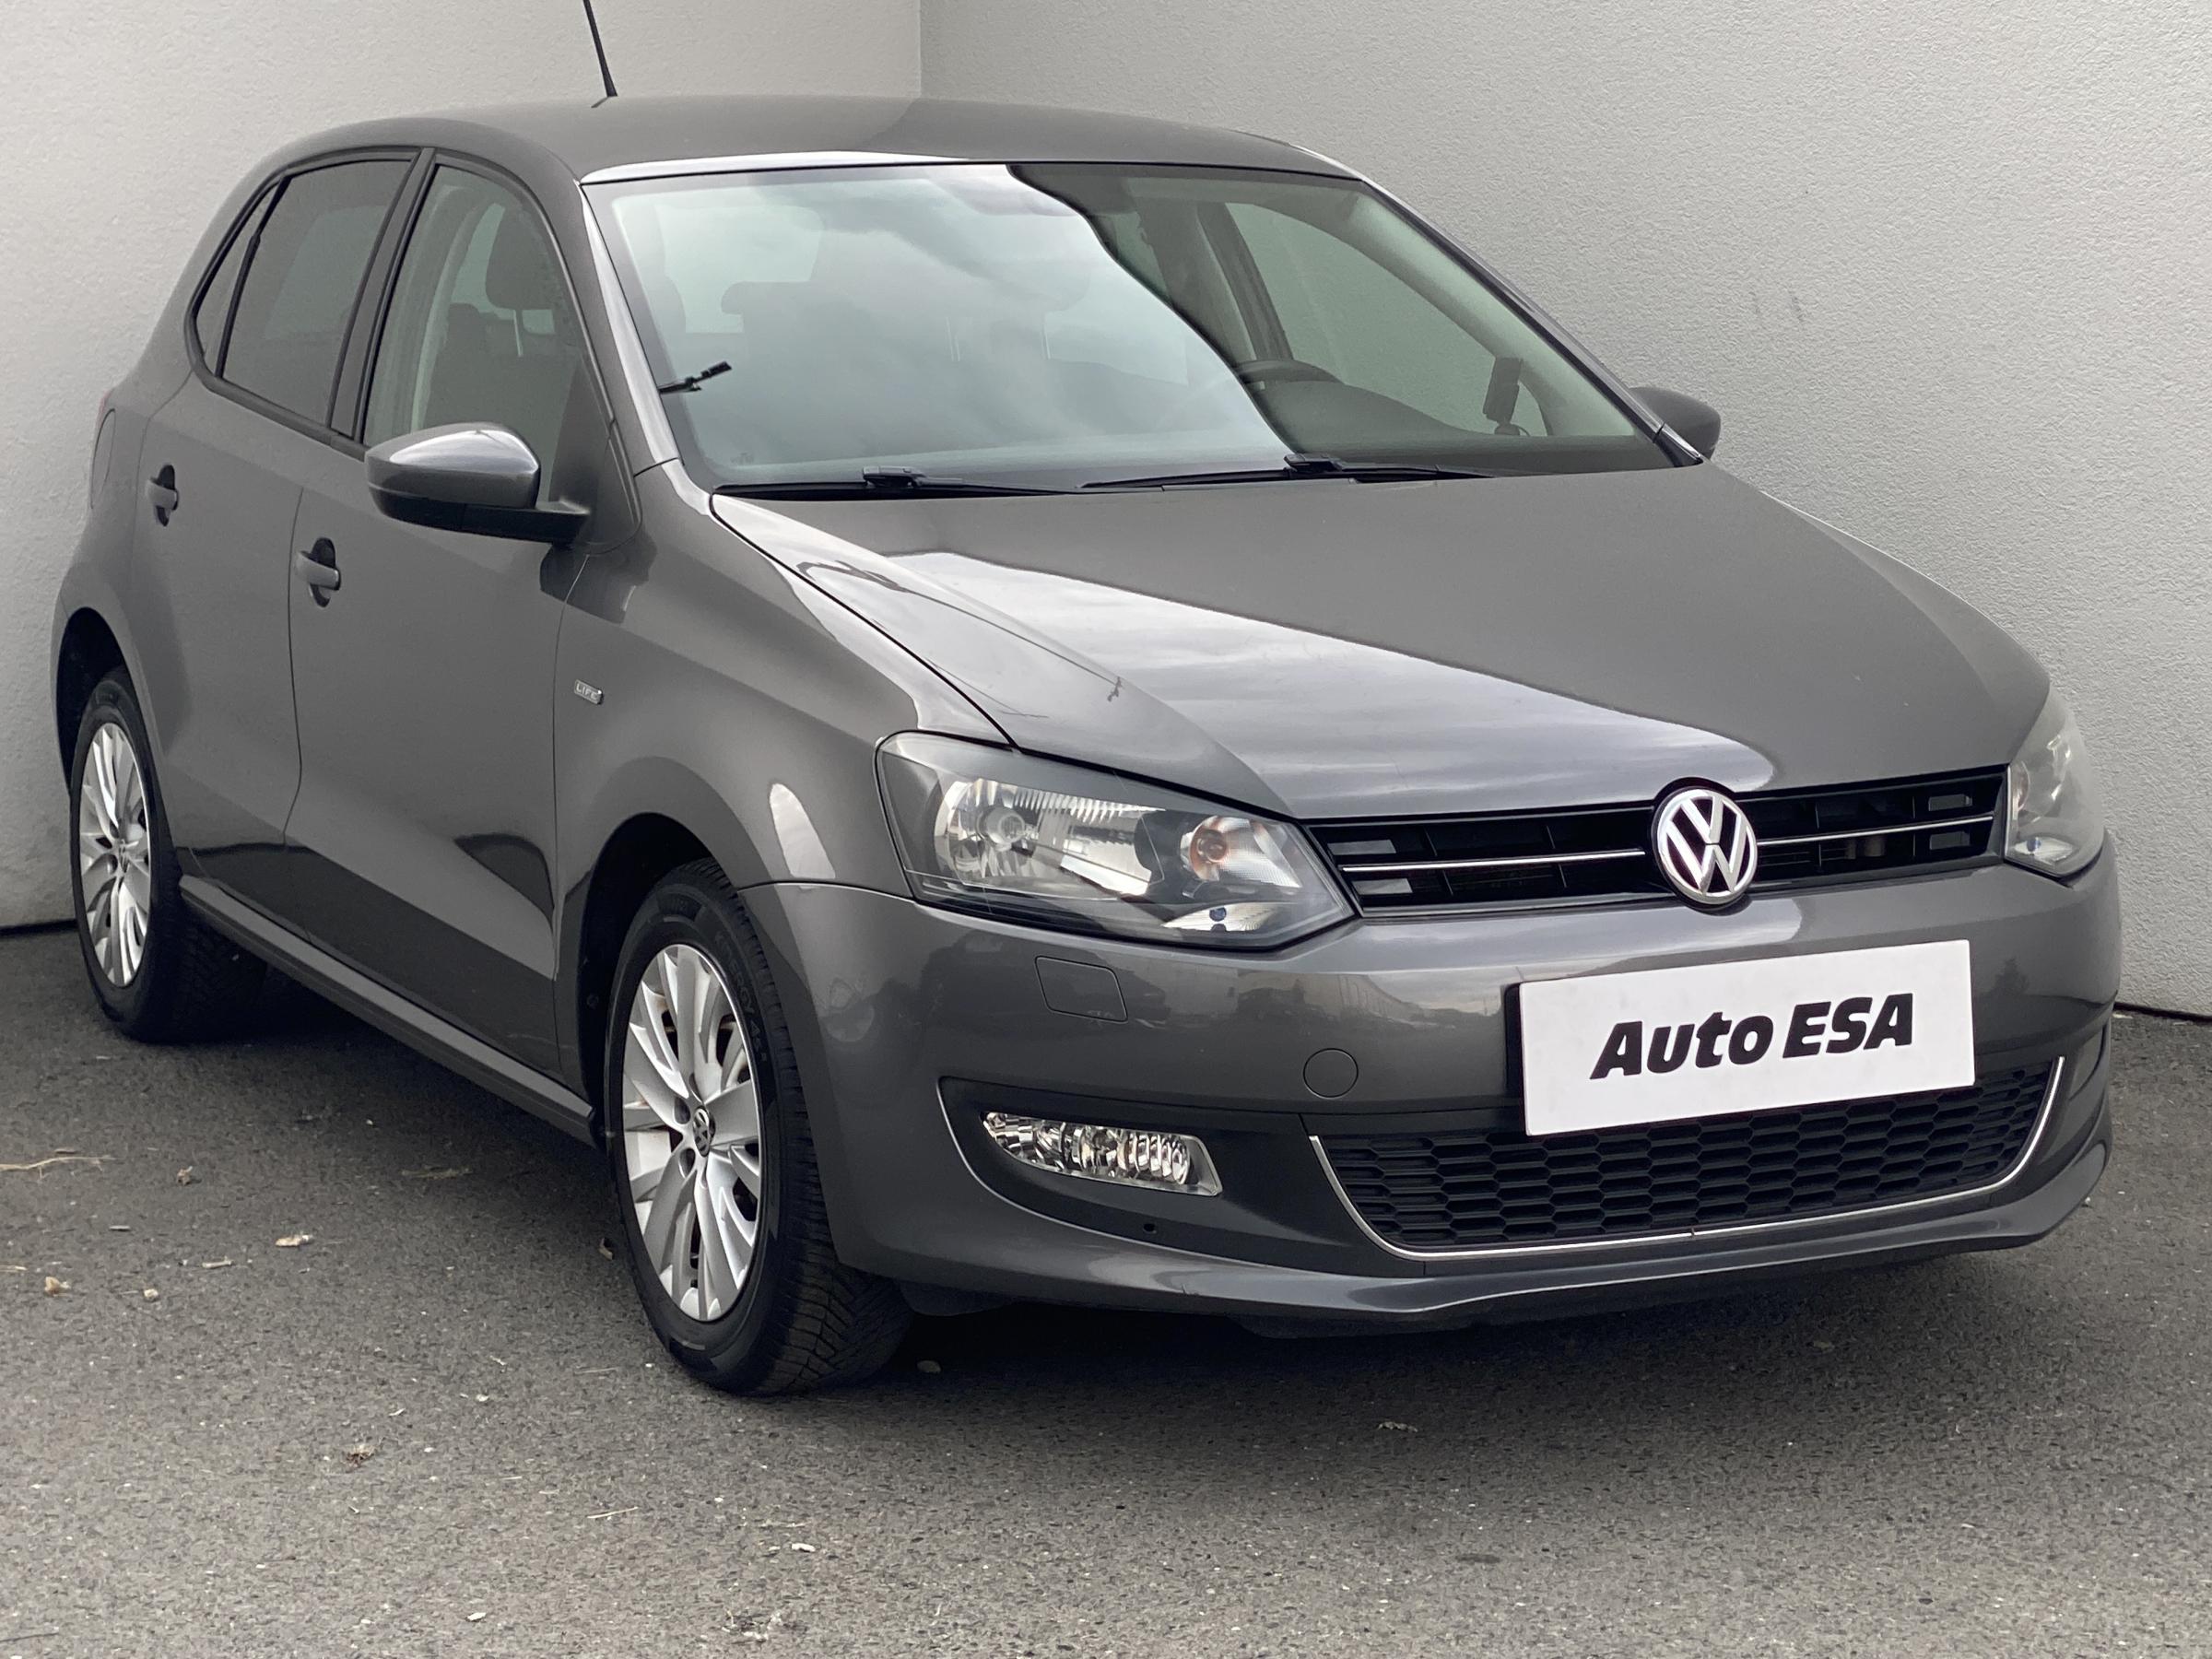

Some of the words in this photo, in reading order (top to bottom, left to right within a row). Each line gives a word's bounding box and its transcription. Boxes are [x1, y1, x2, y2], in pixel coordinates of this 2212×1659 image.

[1661, 792, 1753, 898] VW
[1590, 1011, 1774, 1079] Auto
[1782, 993, 1913, 1059] ESA
